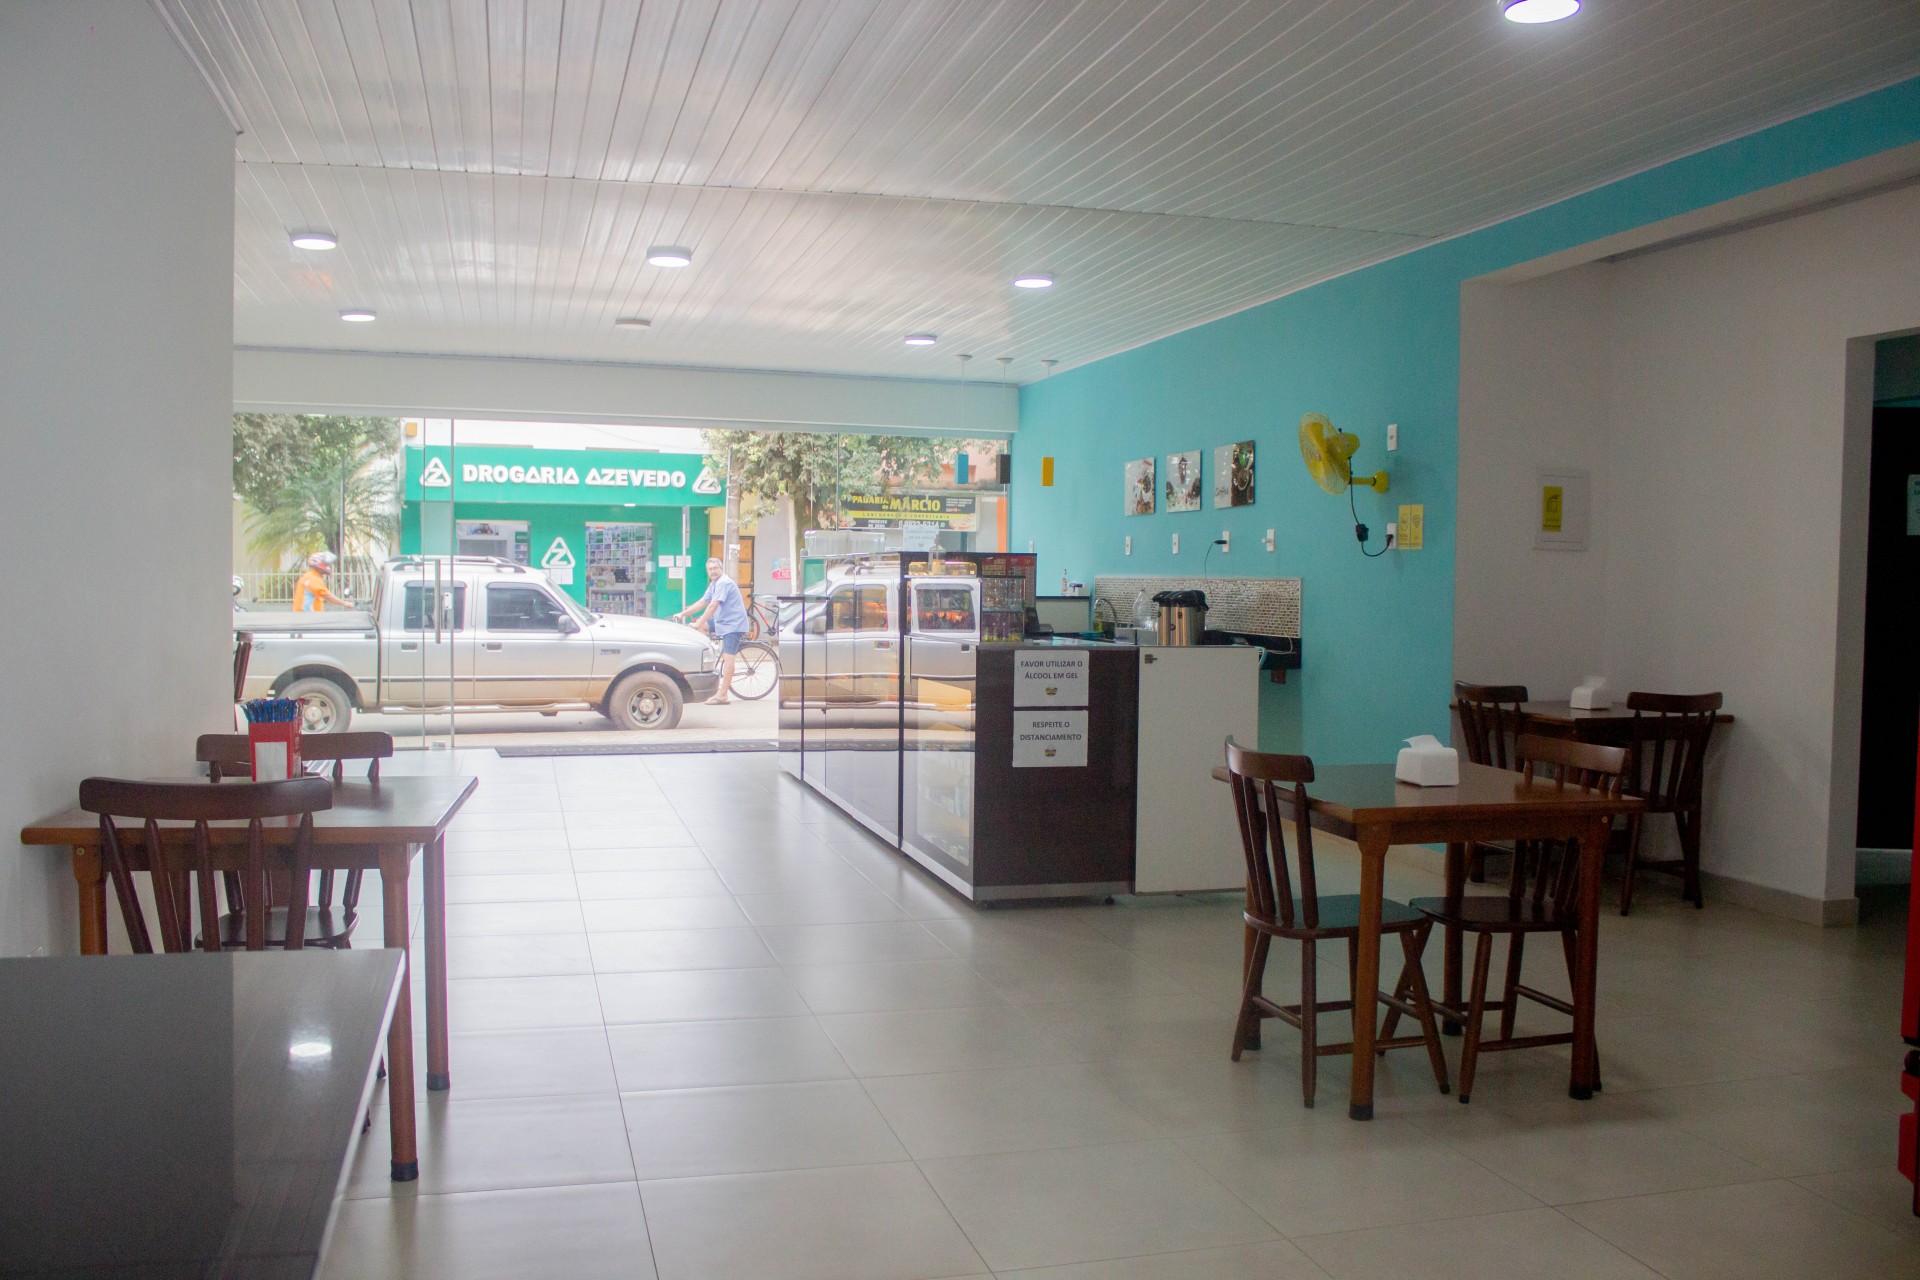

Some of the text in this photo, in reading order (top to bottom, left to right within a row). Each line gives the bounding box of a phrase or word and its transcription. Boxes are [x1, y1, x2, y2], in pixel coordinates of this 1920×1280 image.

[462, 464, 687, 488] DROGARIA AZEVEDO
[1021, 660, 1044, 668] FAVOR
[1045, 660, 1076, 668] UTILIZAR
[1025, 671, 1052, 679] ÁLCOOL
[1020, 733, 1082, 741] DISTANCIAMENTO
